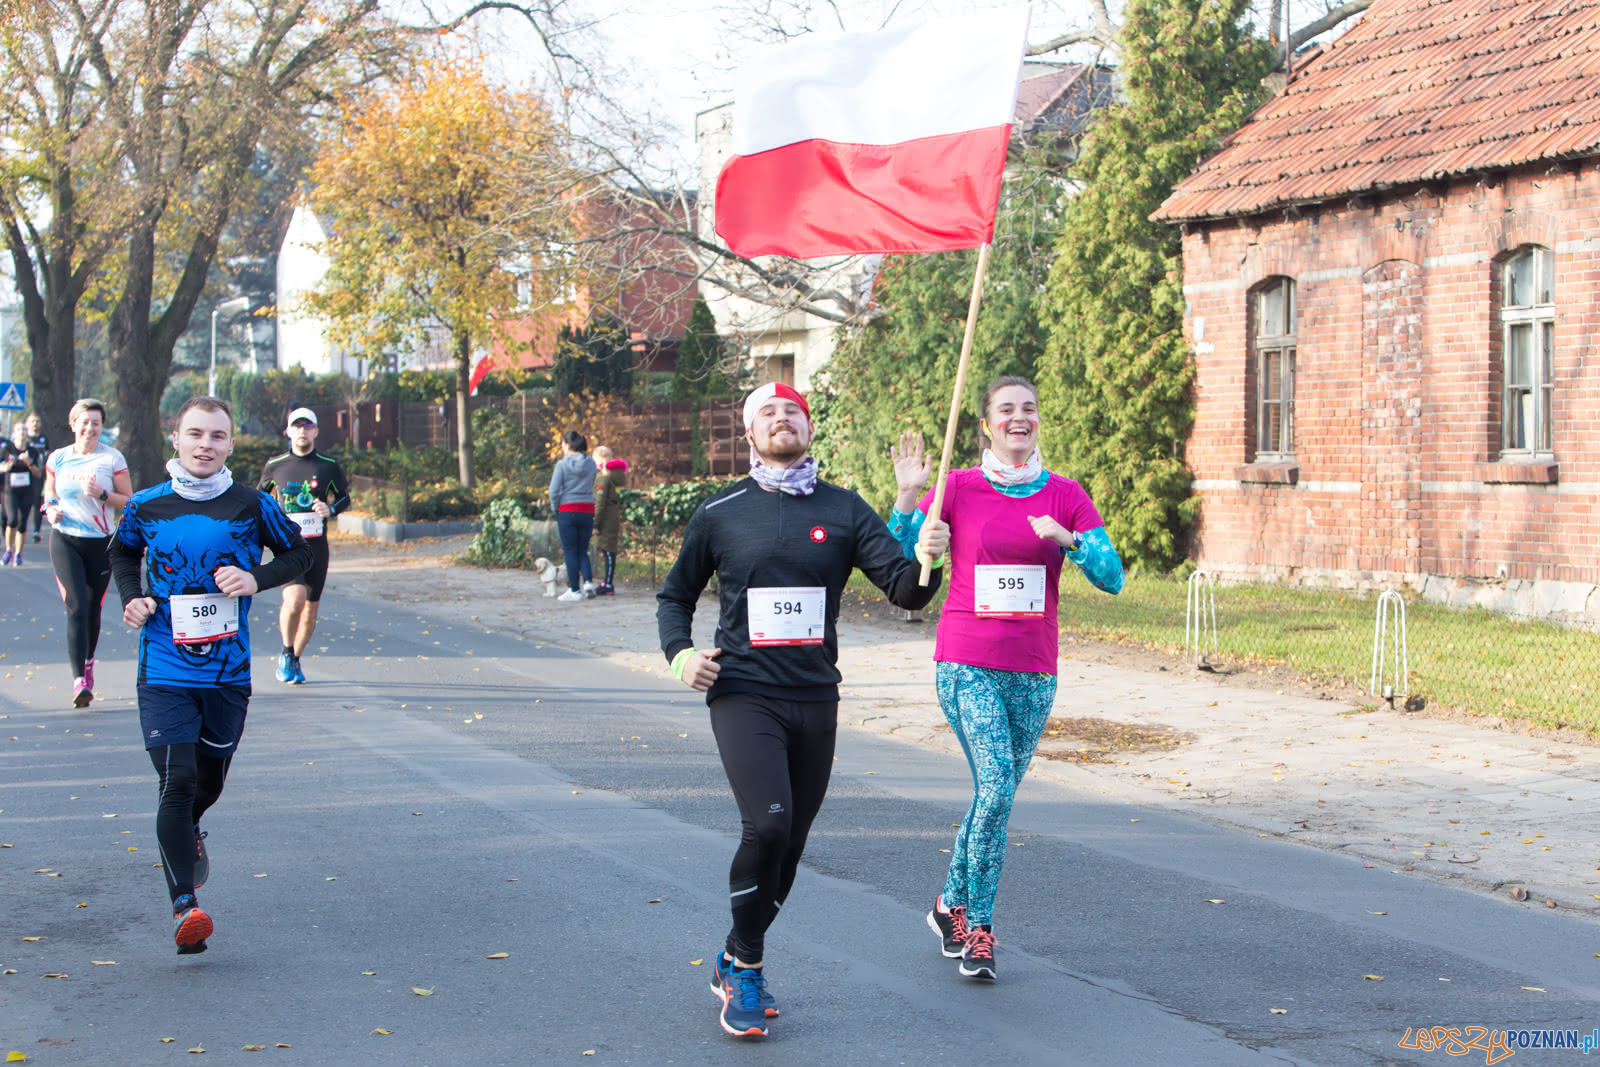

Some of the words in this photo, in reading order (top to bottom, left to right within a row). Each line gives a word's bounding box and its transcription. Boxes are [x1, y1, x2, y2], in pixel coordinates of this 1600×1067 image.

[998, 577, 1025, 590] 595
[192, 604, 217, 618] 580
[773, 601, 803, 615] 594
